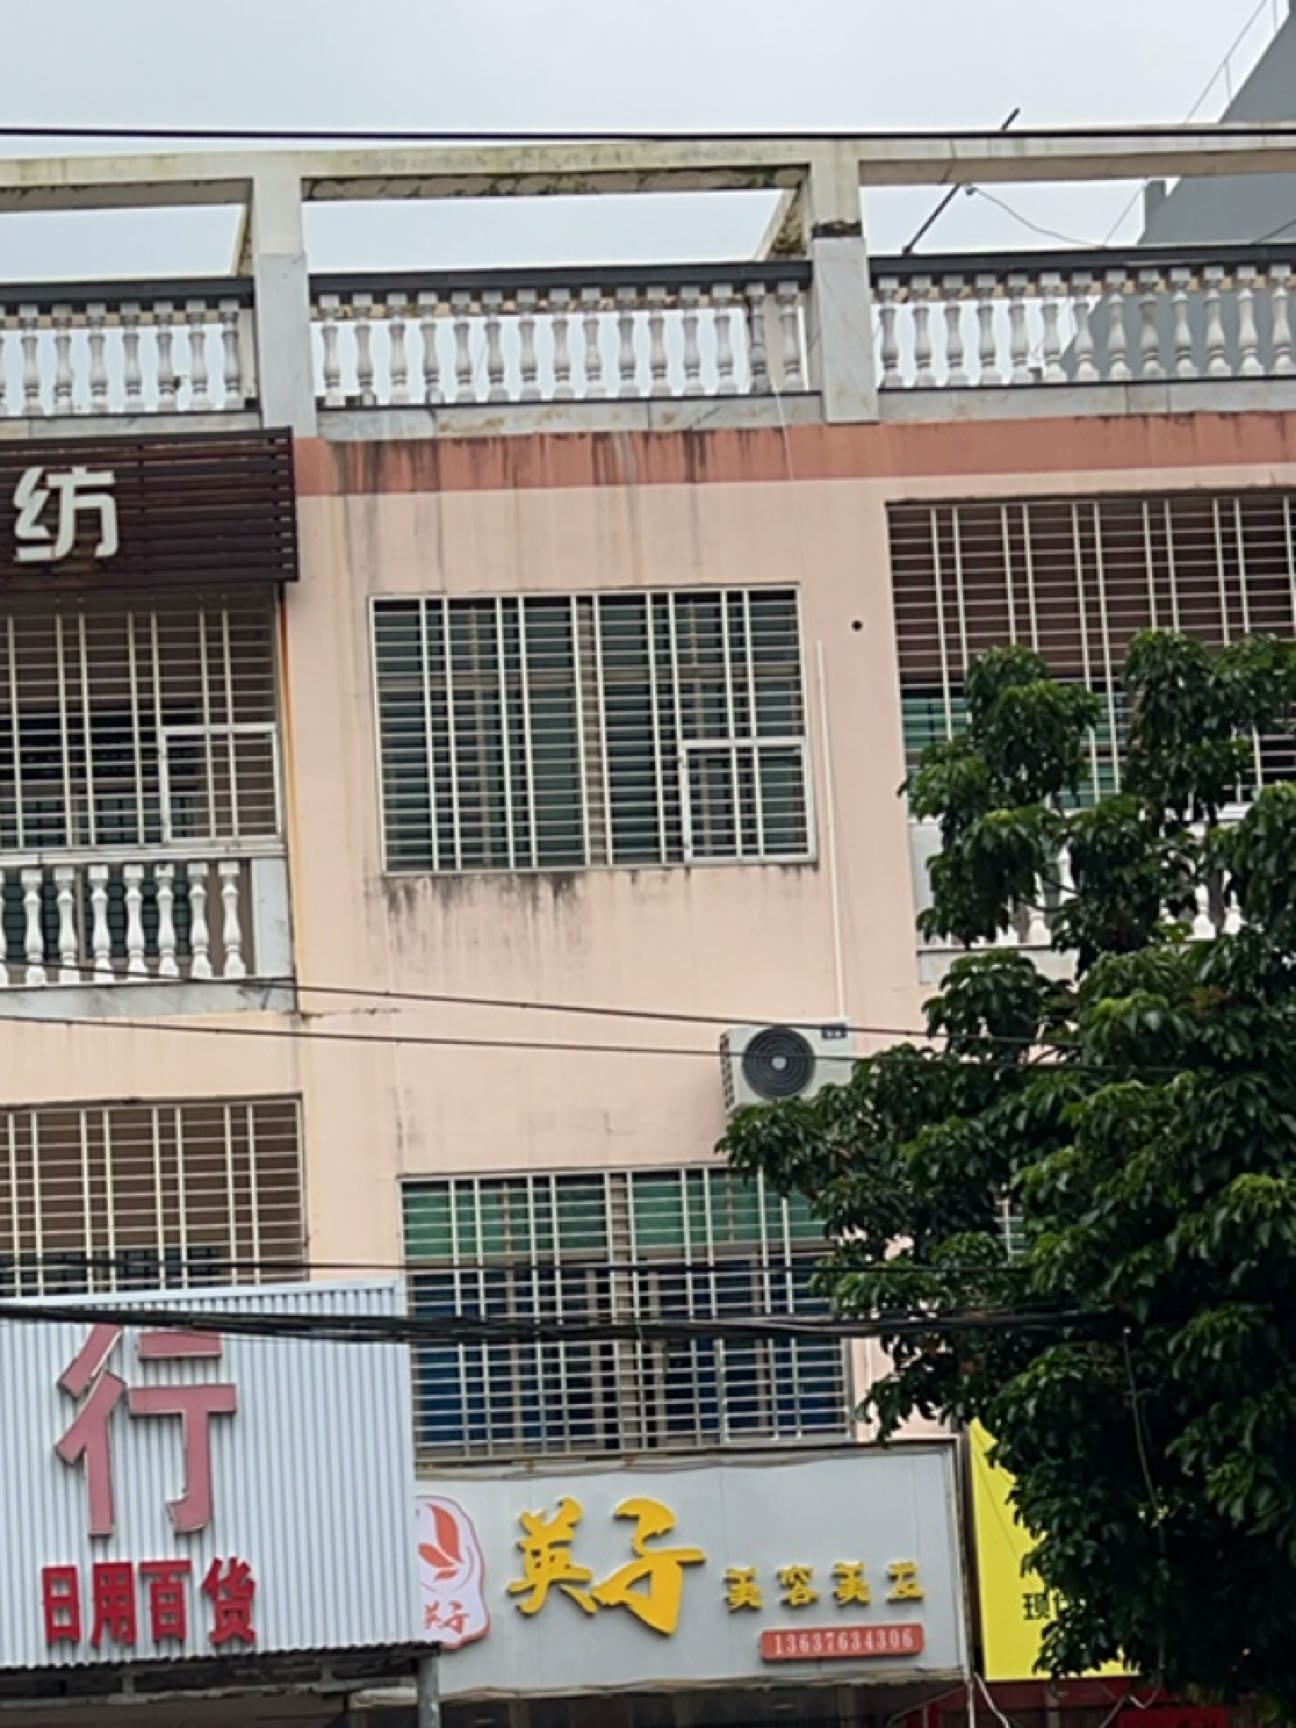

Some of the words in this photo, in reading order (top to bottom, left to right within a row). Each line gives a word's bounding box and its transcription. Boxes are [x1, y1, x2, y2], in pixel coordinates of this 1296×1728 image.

[41, 1556, 256, 1647] 日用百货
[507, 1497, 706, 1636] 英子
[723, 1559, 925, 1613] 美容美发
